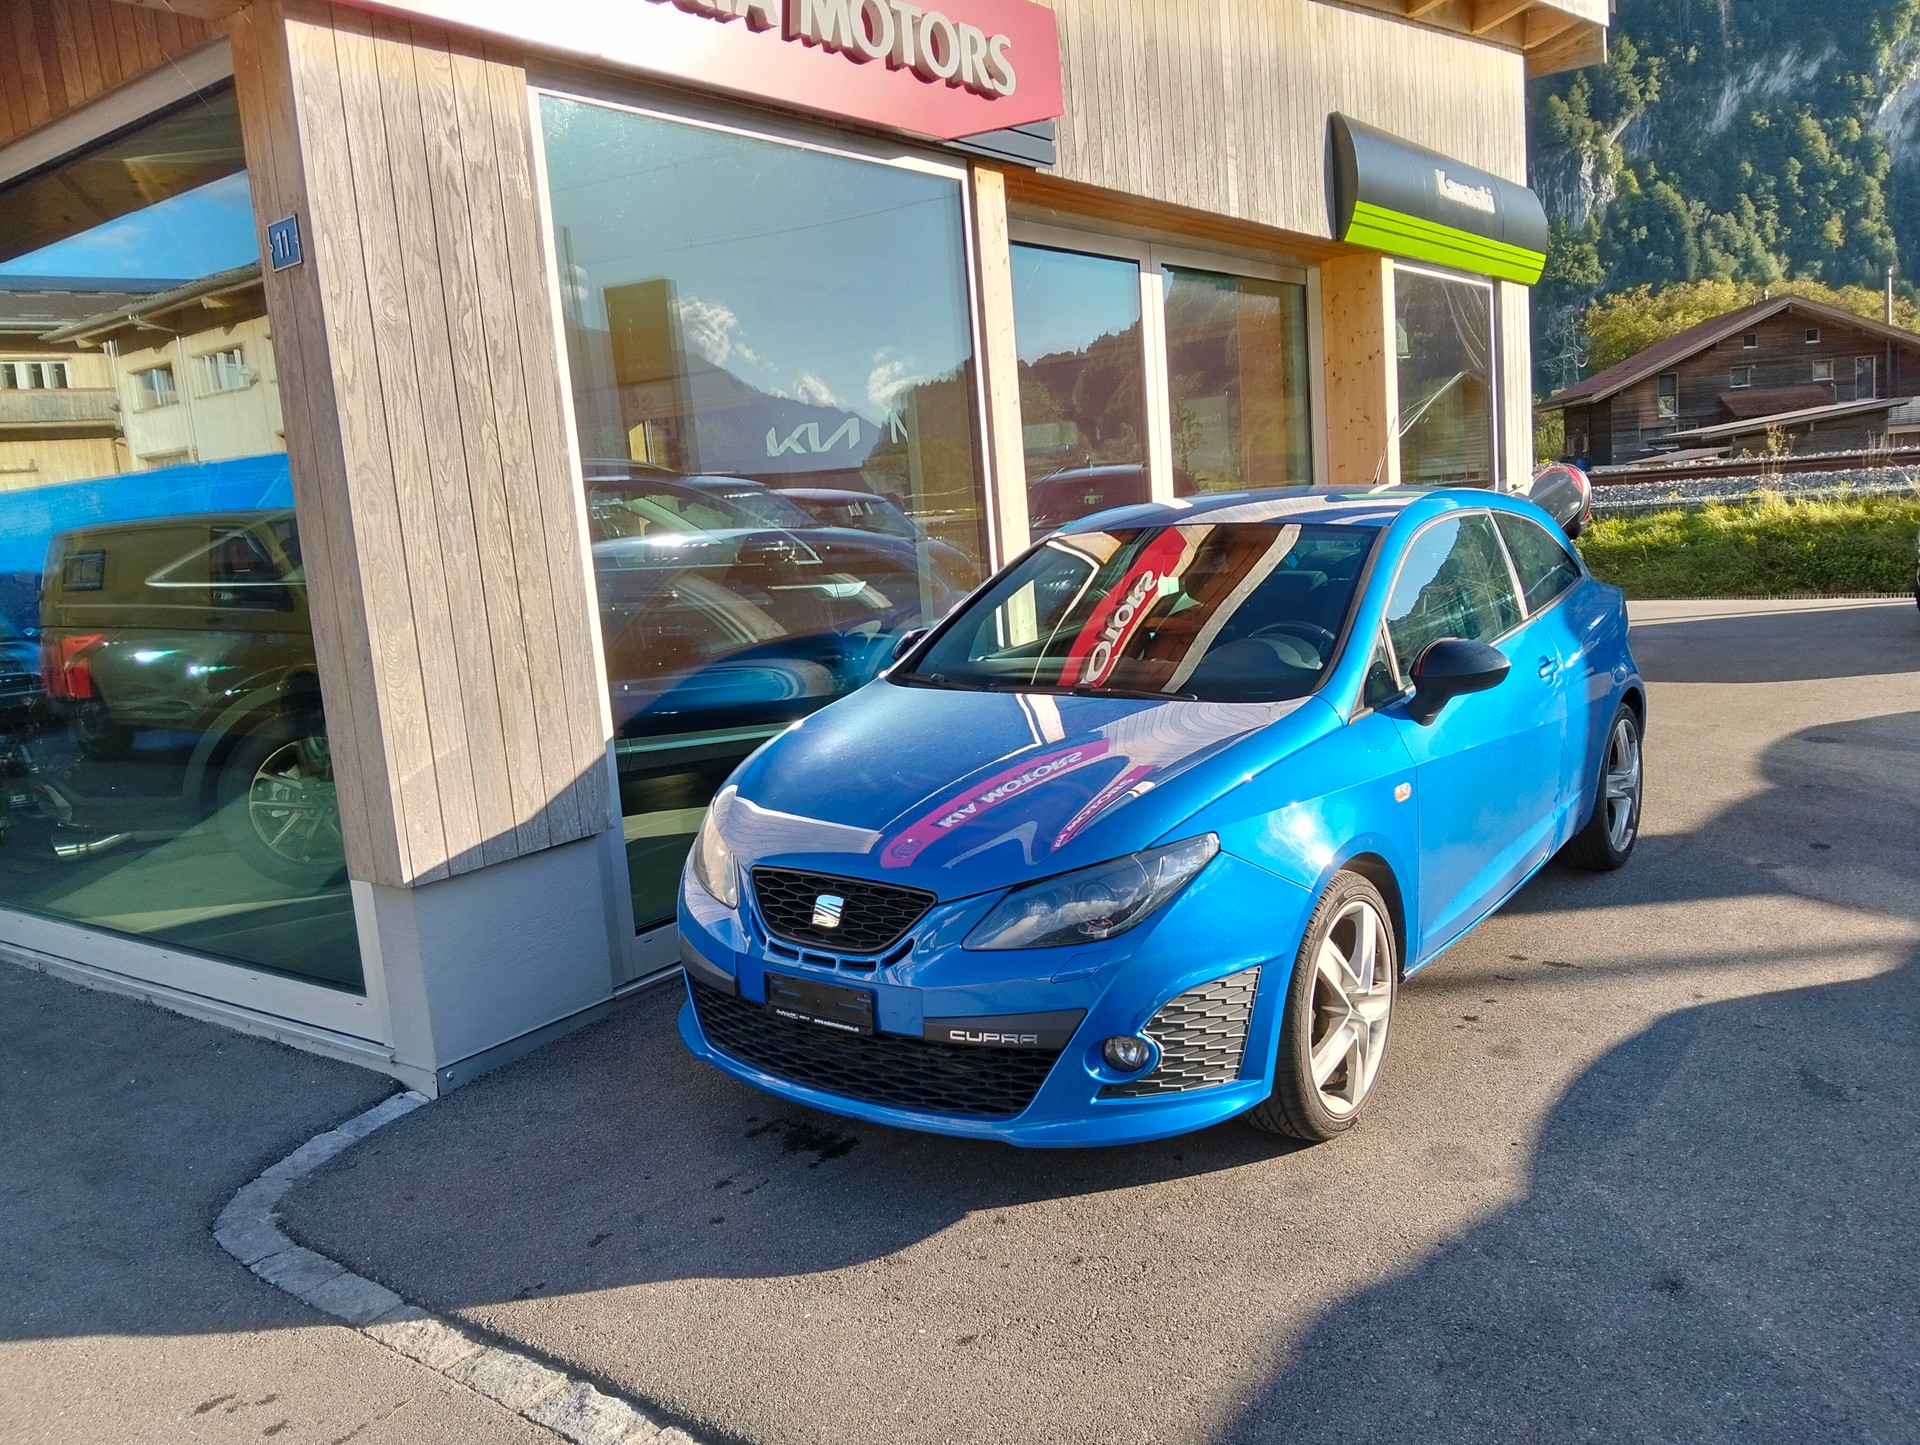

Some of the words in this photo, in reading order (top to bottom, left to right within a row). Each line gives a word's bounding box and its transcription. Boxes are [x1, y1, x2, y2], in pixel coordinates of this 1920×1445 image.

[783, 0, 1017, 99] MOTORS
[275, 229, 291, 259] 11
[949, 1029, 1038, 1044] CUPRA
